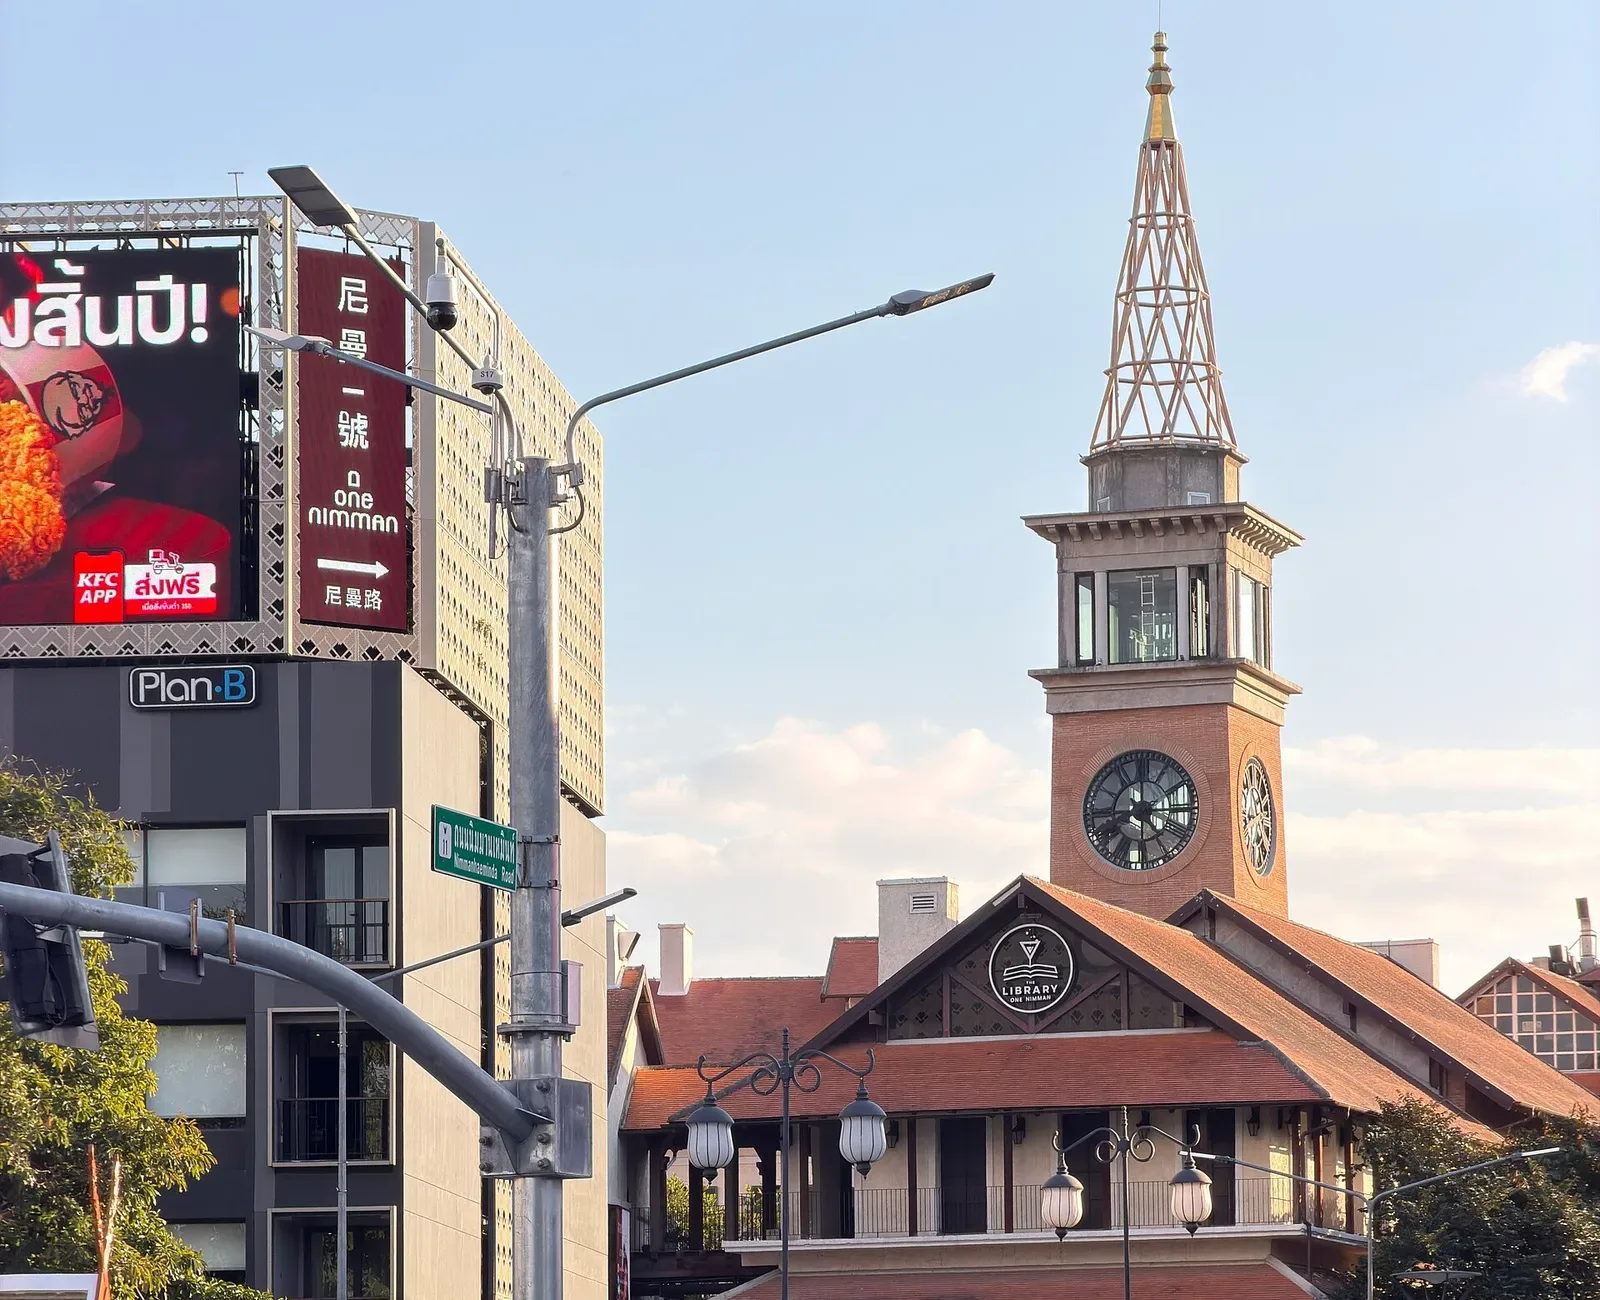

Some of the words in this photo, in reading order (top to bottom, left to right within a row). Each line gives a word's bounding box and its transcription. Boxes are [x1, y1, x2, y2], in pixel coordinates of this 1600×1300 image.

[334, 489, 374, 509] one
[77, 572, 119, 587] KFC
[135, 572, 200, 596] ส่งฟรี
[79, 589, 117, 604] APP
[325, 585, 383, 611] 尼曼路
[501, 866, 515, 885] Road
[1002, 984, 1058, 996] LIBRARY
